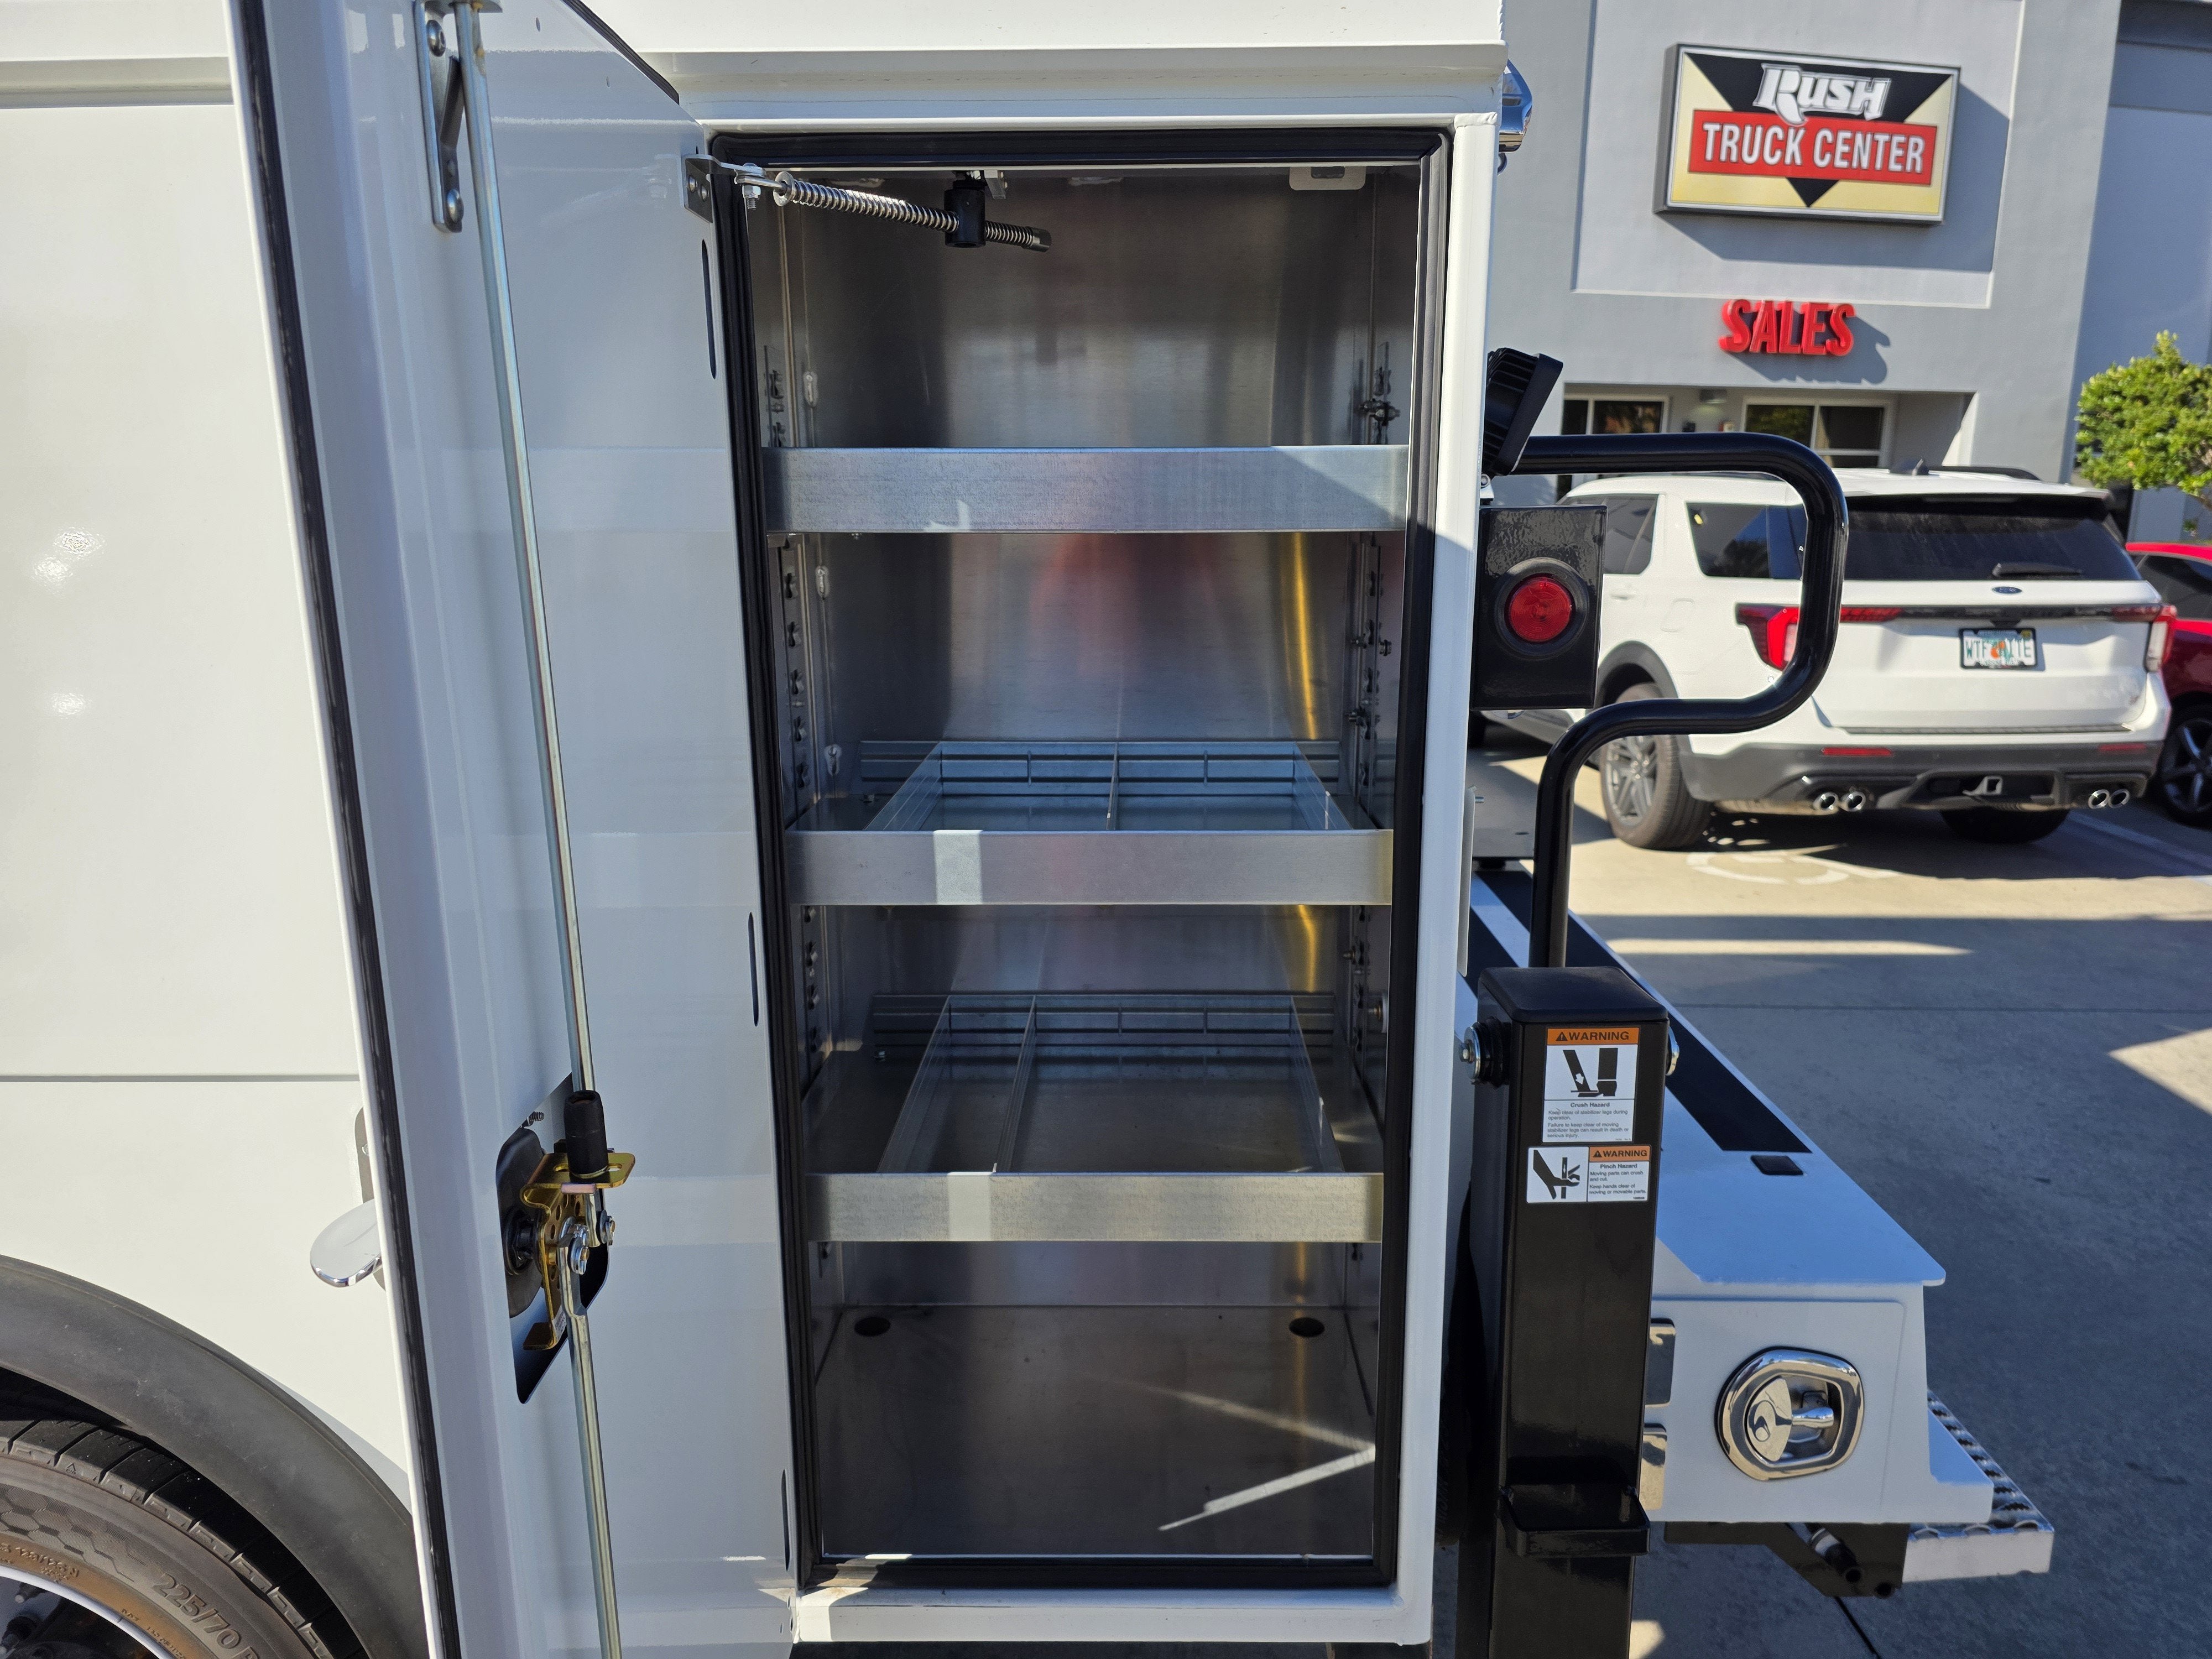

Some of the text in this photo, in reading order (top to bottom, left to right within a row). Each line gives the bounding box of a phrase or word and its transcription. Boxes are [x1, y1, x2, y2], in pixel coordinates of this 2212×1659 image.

[1752, 62, 1892, 125] RUSH
[1703, 122, 1925, 173] TRUCK CENTER
[1718, 298, 1856, 357] SALES
[1568, 1031, 1630, 1041] WARNING
